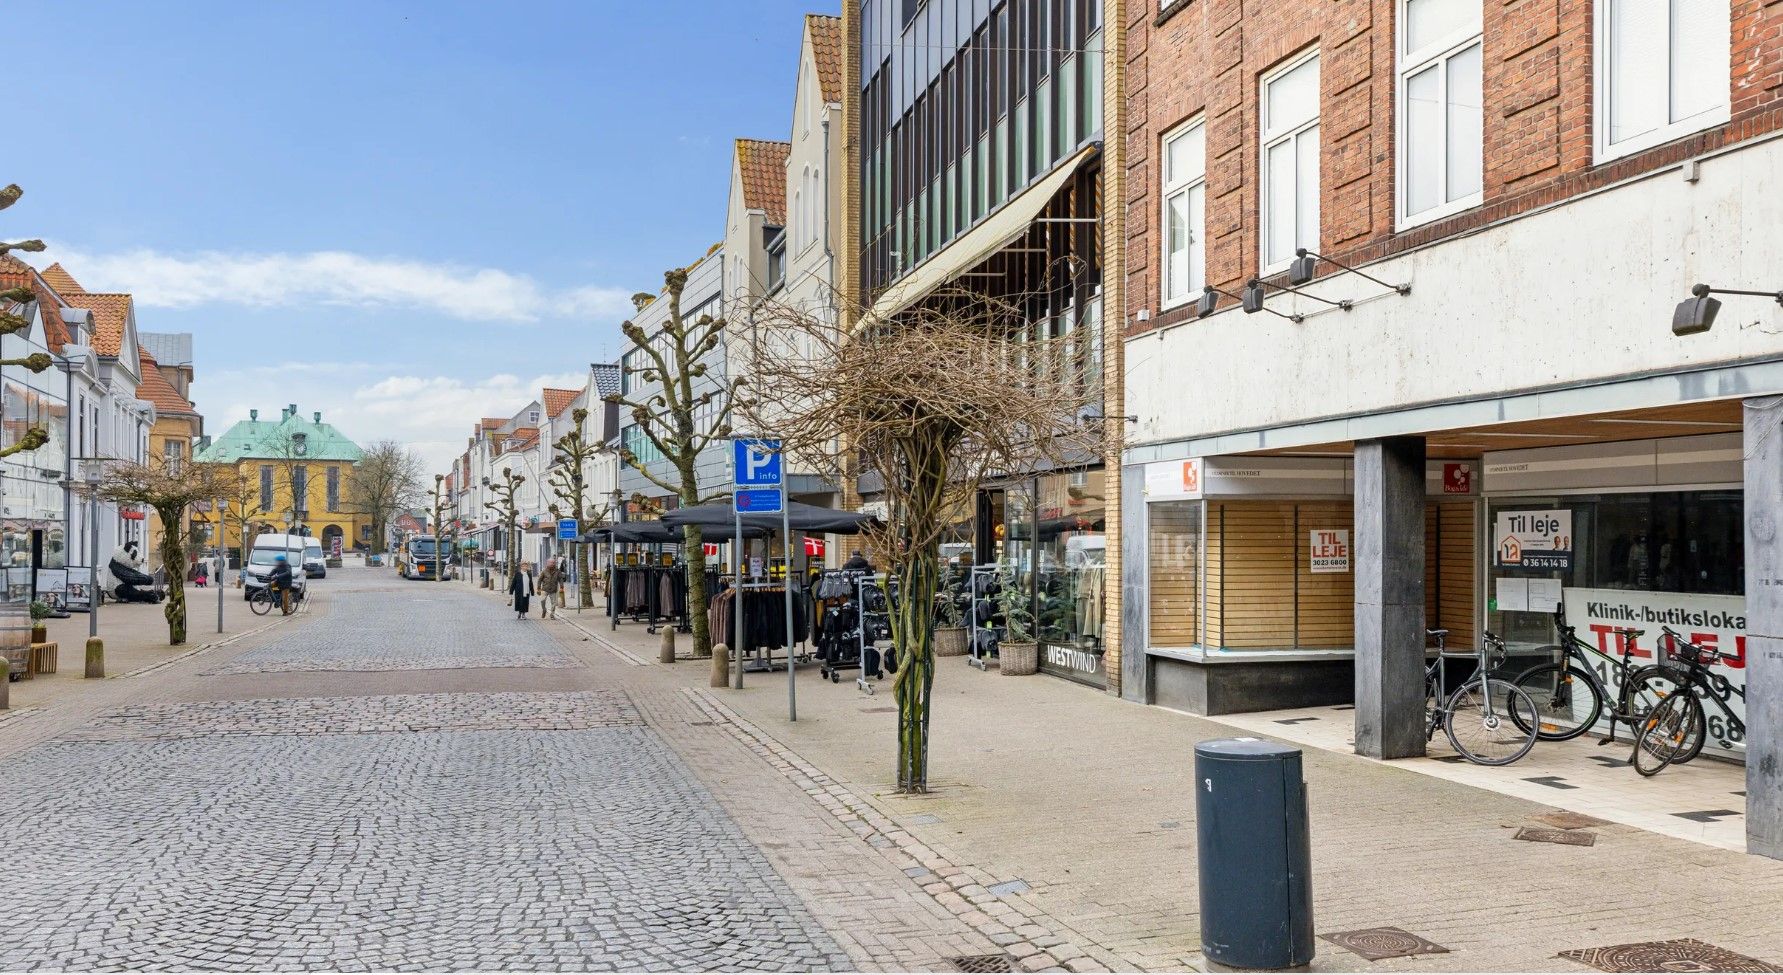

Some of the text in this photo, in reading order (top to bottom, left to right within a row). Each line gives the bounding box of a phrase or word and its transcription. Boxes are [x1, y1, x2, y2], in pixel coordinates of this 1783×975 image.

[746, 444, 772, 480] P
[759, 472, 778, 480] info
[1508, 514, 1560, 537] Til leje
[1317, 532, 1341, 545] TIL
[1312, 545, 1347, 558] LEJE
[1530, 558, 1568, 568] 36 14 14 18
[1589, 623, 1652, 659] TIL
[1047, 644, 1096, 674] WESTWIND
